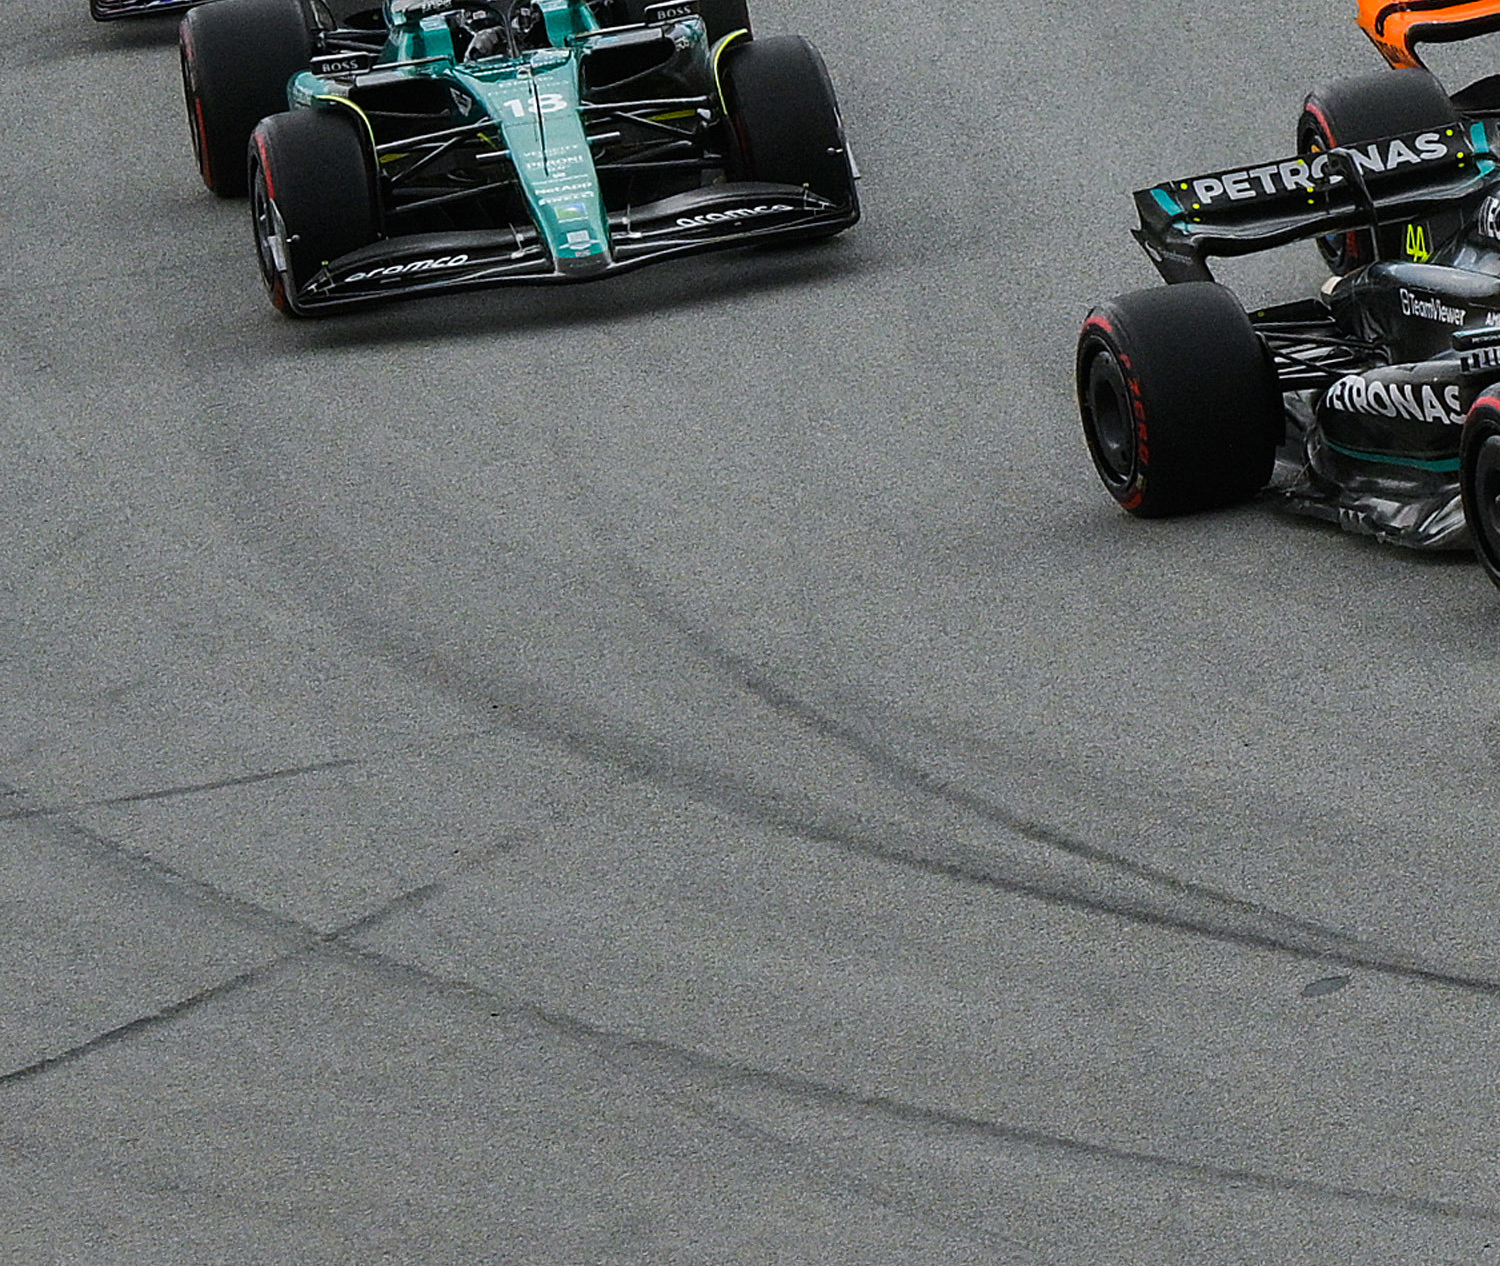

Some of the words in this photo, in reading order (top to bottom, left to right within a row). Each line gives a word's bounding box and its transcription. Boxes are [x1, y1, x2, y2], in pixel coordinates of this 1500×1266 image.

[656, 5, 692, 20] BOSS
[321, 59, 359, 73] BOSS
[503, 93, 568, 118] 18
[1192, 131, 1450, 205] PETRONAS
[675, 204, 794, 228] aramco
[1406, 223, 1429, 263] 44
[344, 253, 469, 282] aramco
[1409, 291, 1467, 328] TeamViewer
[1325, 373, 1468, 426] PETRONAS
